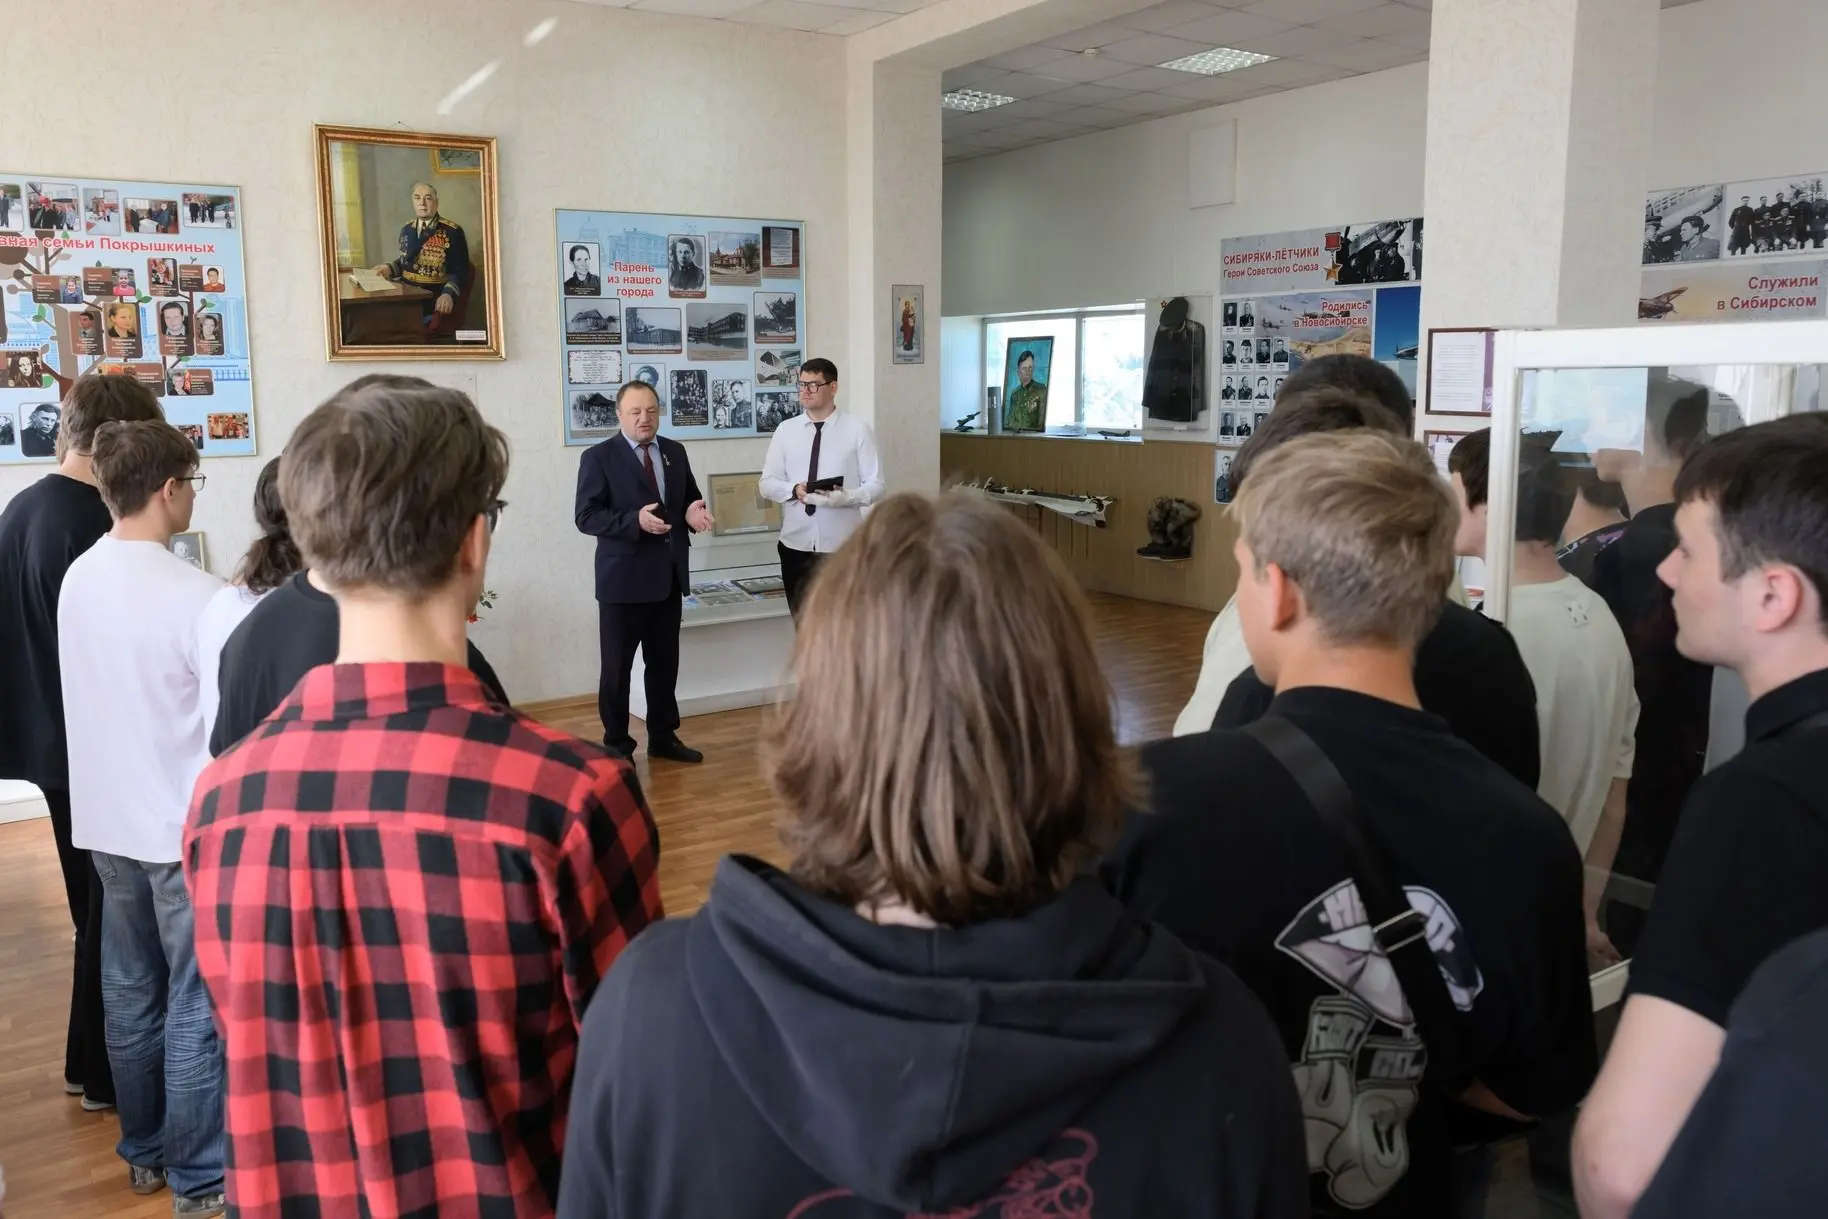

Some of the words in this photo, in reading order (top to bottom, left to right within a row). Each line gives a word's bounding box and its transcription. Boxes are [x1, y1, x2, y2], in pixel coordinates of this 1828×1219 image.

[43, 237, 94, 249] семьи
[100, 238, 215, 253] Покрышкиных
[1223, 246, 1320, 266] СИБИРЯКИ-ЛЁТЧИКИ
[614, 261, 656, 274] Парень
[1223, 269, 1246, 279] Герои
[1247, 264, 1291, 277] Советского
[1292, 262, 1320, 273] Союза
[607, 275, 620, 284] из
[623, 276, 662, 285] нашего
[1748, 276, 1818, 291] Служили
[616, 288, 654, 299] города
[1322, 301, 1369, 313] Родились
[1717, 300, 1726, 310] в
[1730, 296, 1817, 311] Сибирском
[1294, 319, 1300, 328] в
[1302, 317, 1368, 327] Новосибирске
